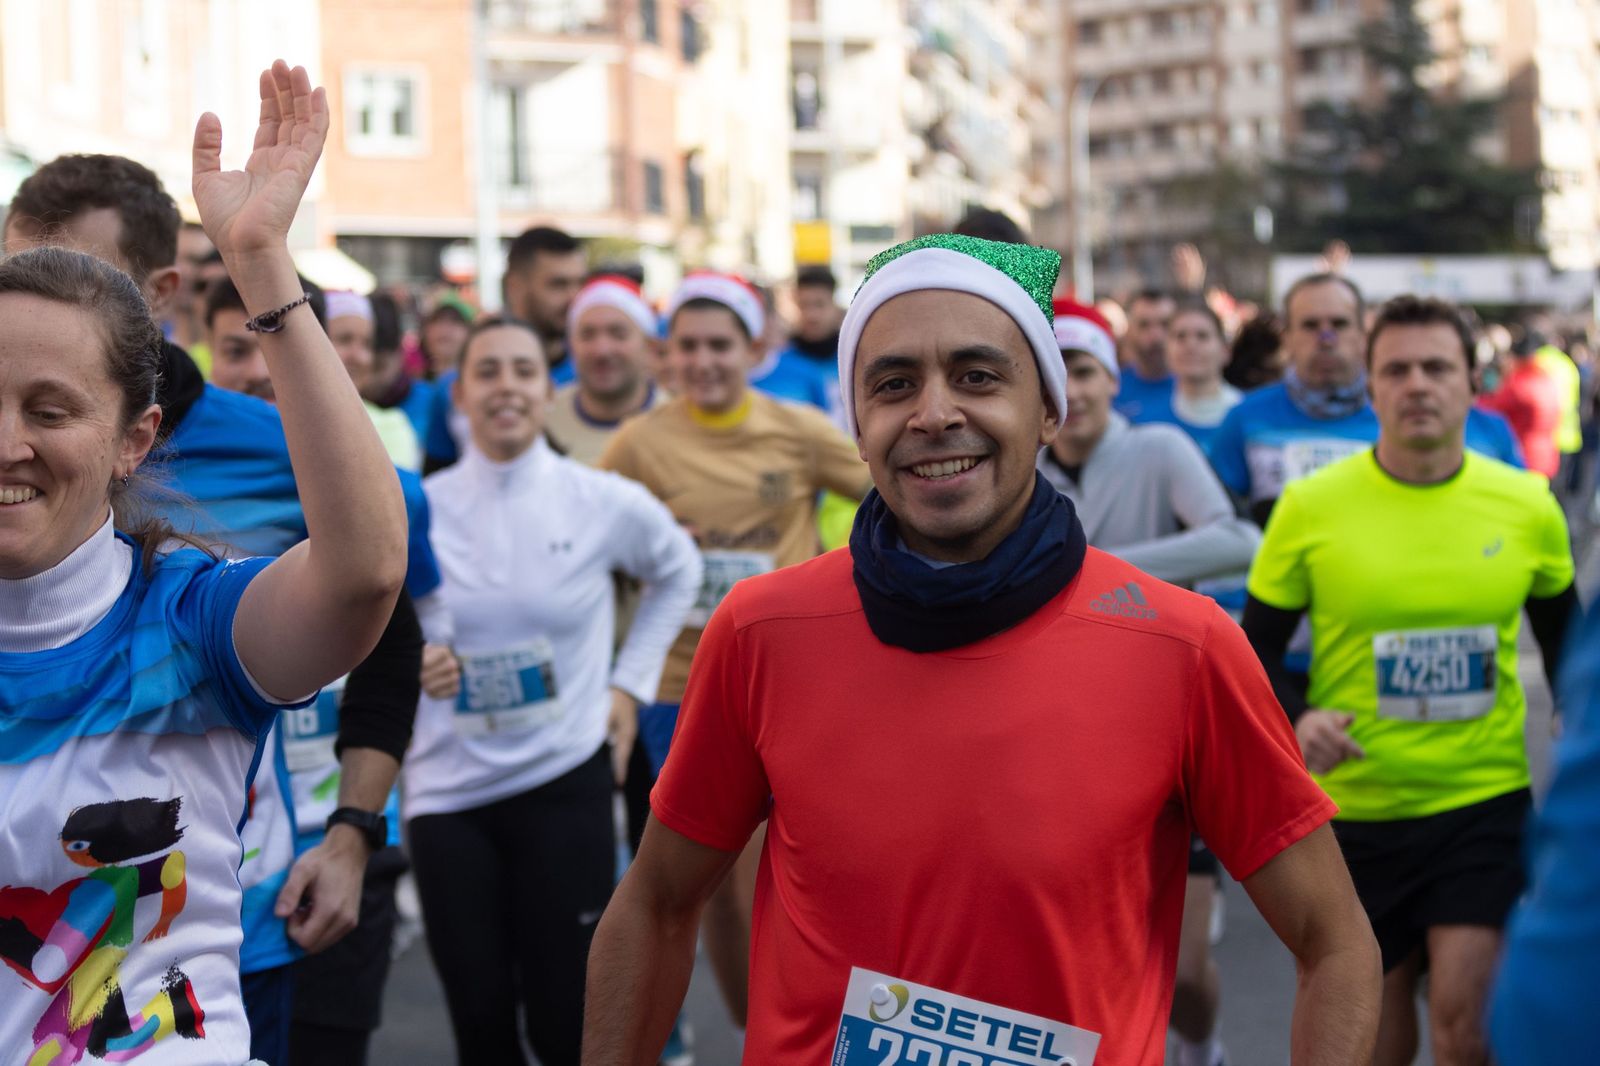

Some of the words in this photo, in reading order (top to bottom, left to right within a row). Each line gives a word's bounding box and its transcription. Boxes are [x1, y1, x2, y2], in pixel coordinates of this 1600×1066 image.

[1089, 599, 1158, 620] adidas
[1391, 653, 1470, 692] 4250
[911, 998, 1061, 1062] SETEL
